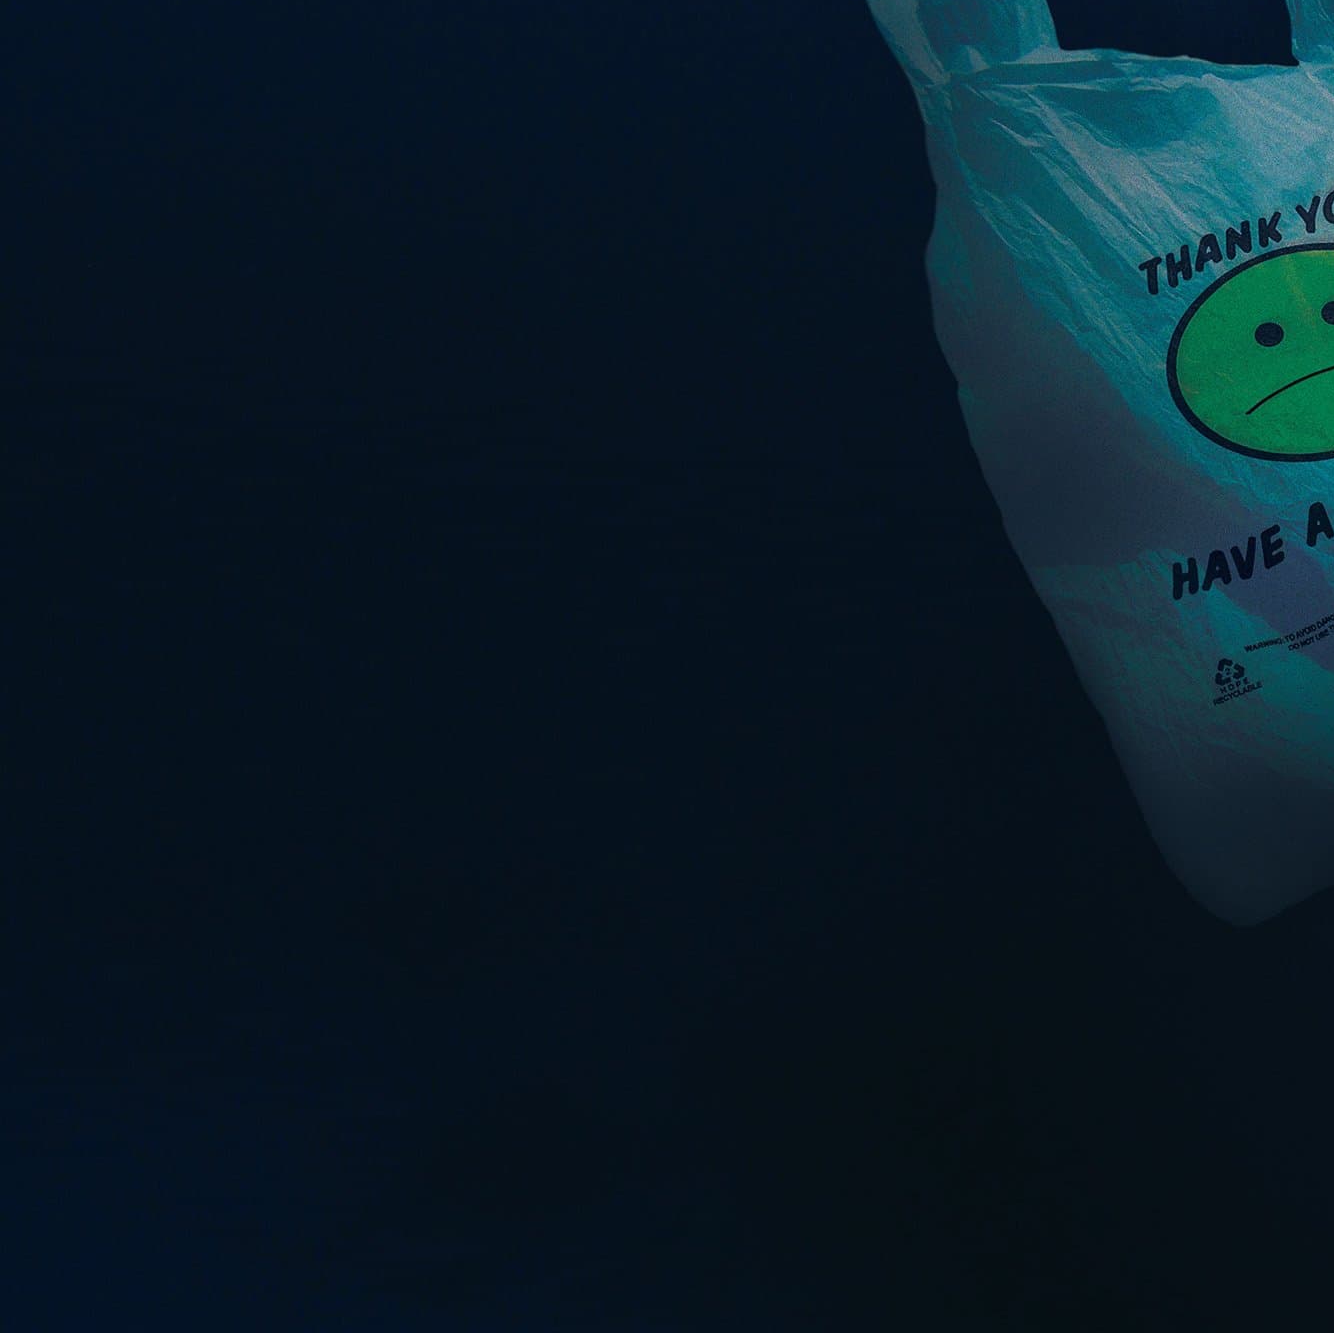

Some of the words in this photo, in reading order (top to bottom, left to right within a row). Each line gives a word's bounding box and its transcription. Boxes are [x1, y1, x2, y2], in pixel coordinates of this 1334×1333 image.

[1138, 211, 1282, 295] THANK
[1172, 525, 1286, 600] HAVE
[1306, 501, 1334, 547] A
[1285, 633, 1296, 643] TO
[1296, 624, 1317, 639] AVOID
[1288, 643, 1300, 651] DO
[1300, 636, 1315, 648] NOT
